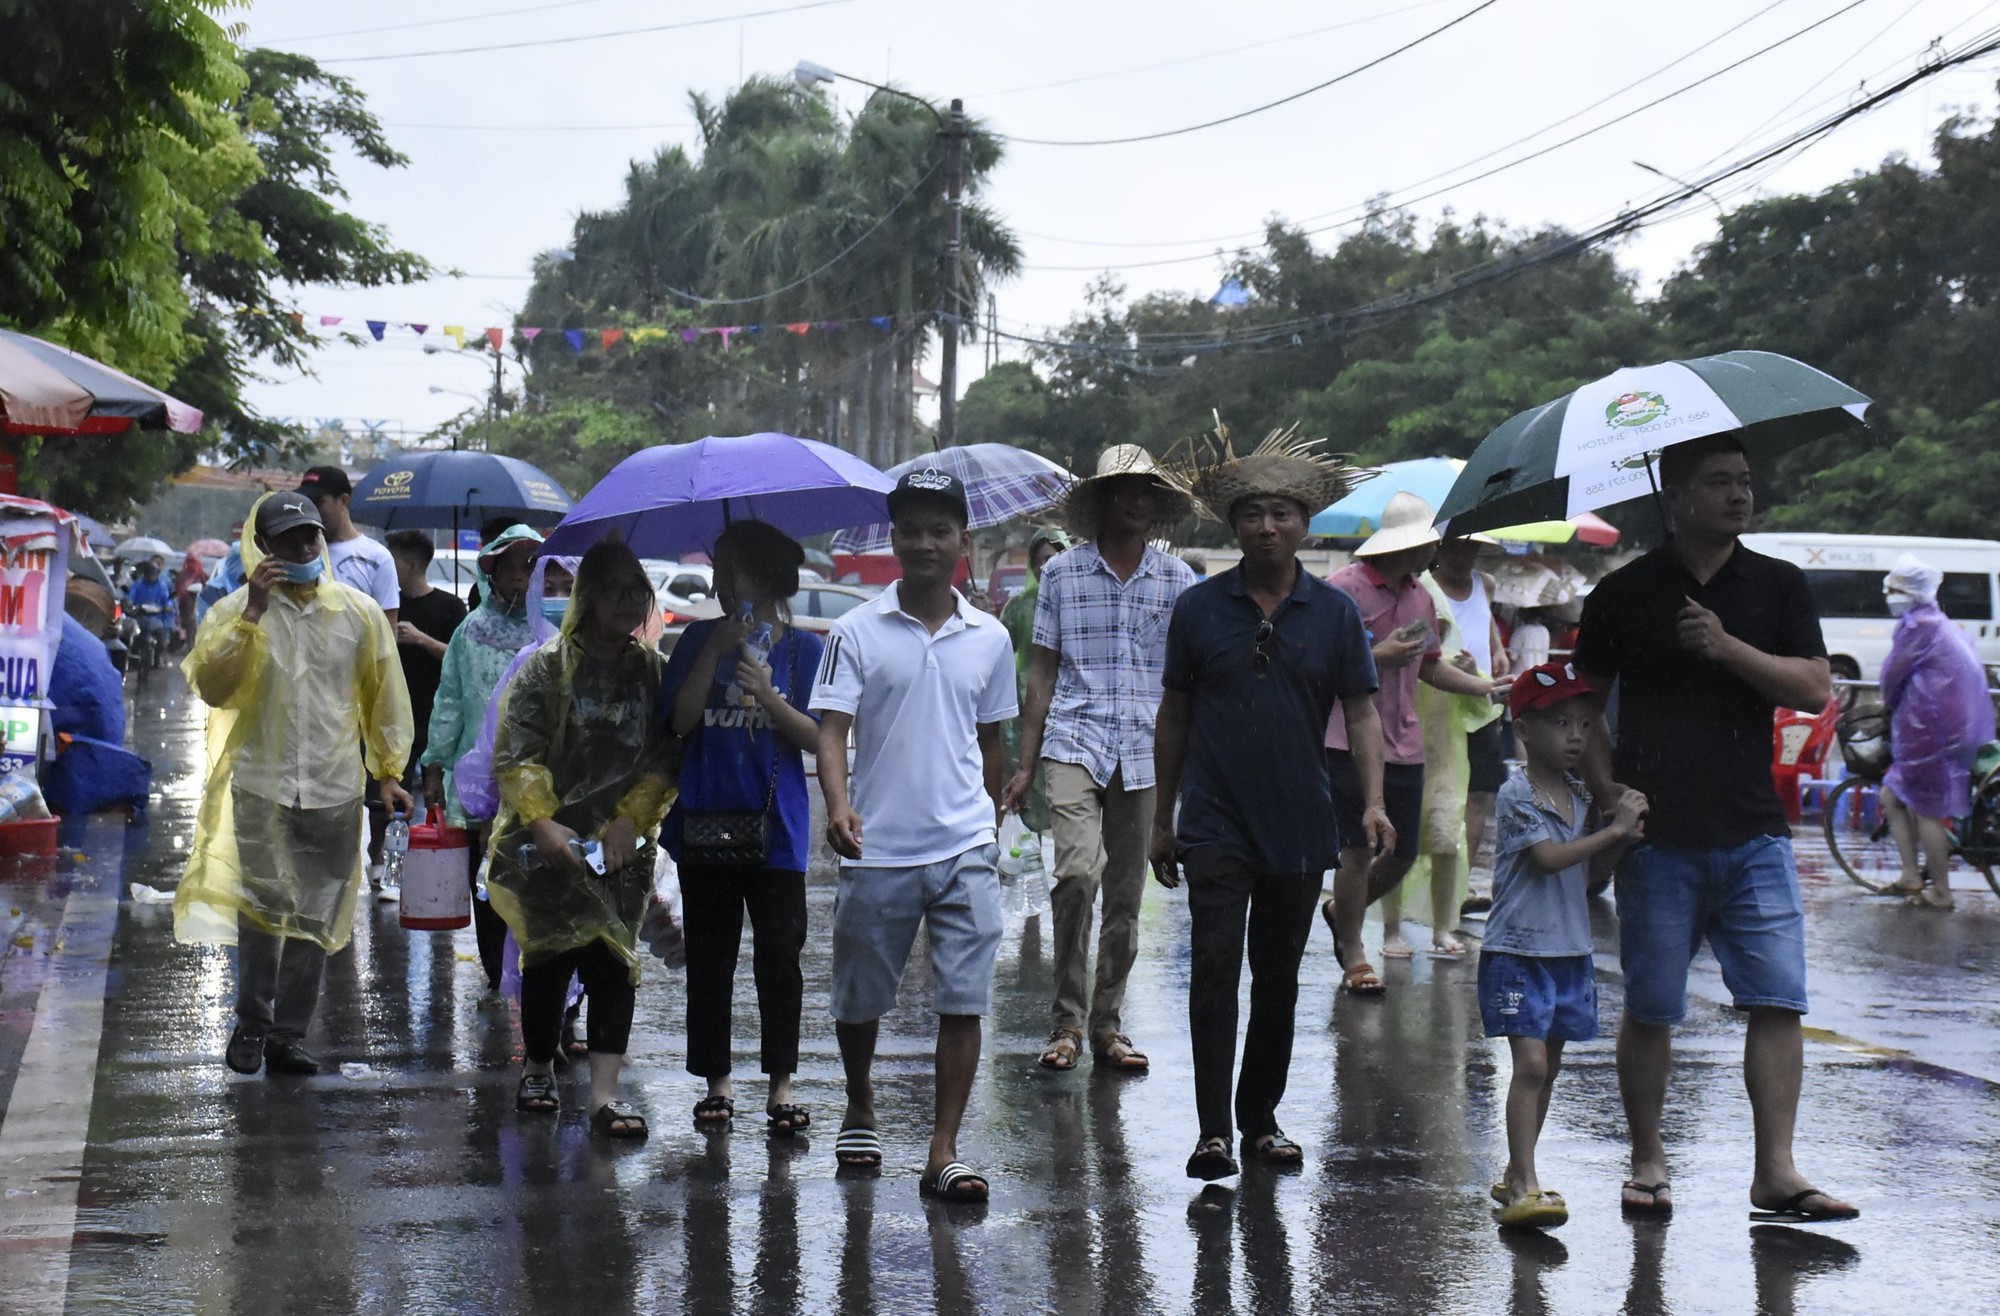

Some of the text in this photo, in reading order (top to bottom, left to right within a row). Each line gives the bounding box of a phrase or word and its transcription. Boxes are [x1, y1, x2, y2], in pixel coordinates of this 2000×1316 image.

[1635, 423, 1661, 436] 1900
[1664, 417, 1684, 429] 571
[1688, 410, 1710, 421] 555
[374, 486, 411, 496] TOYOTA
[0, 719, 30, 742] P
